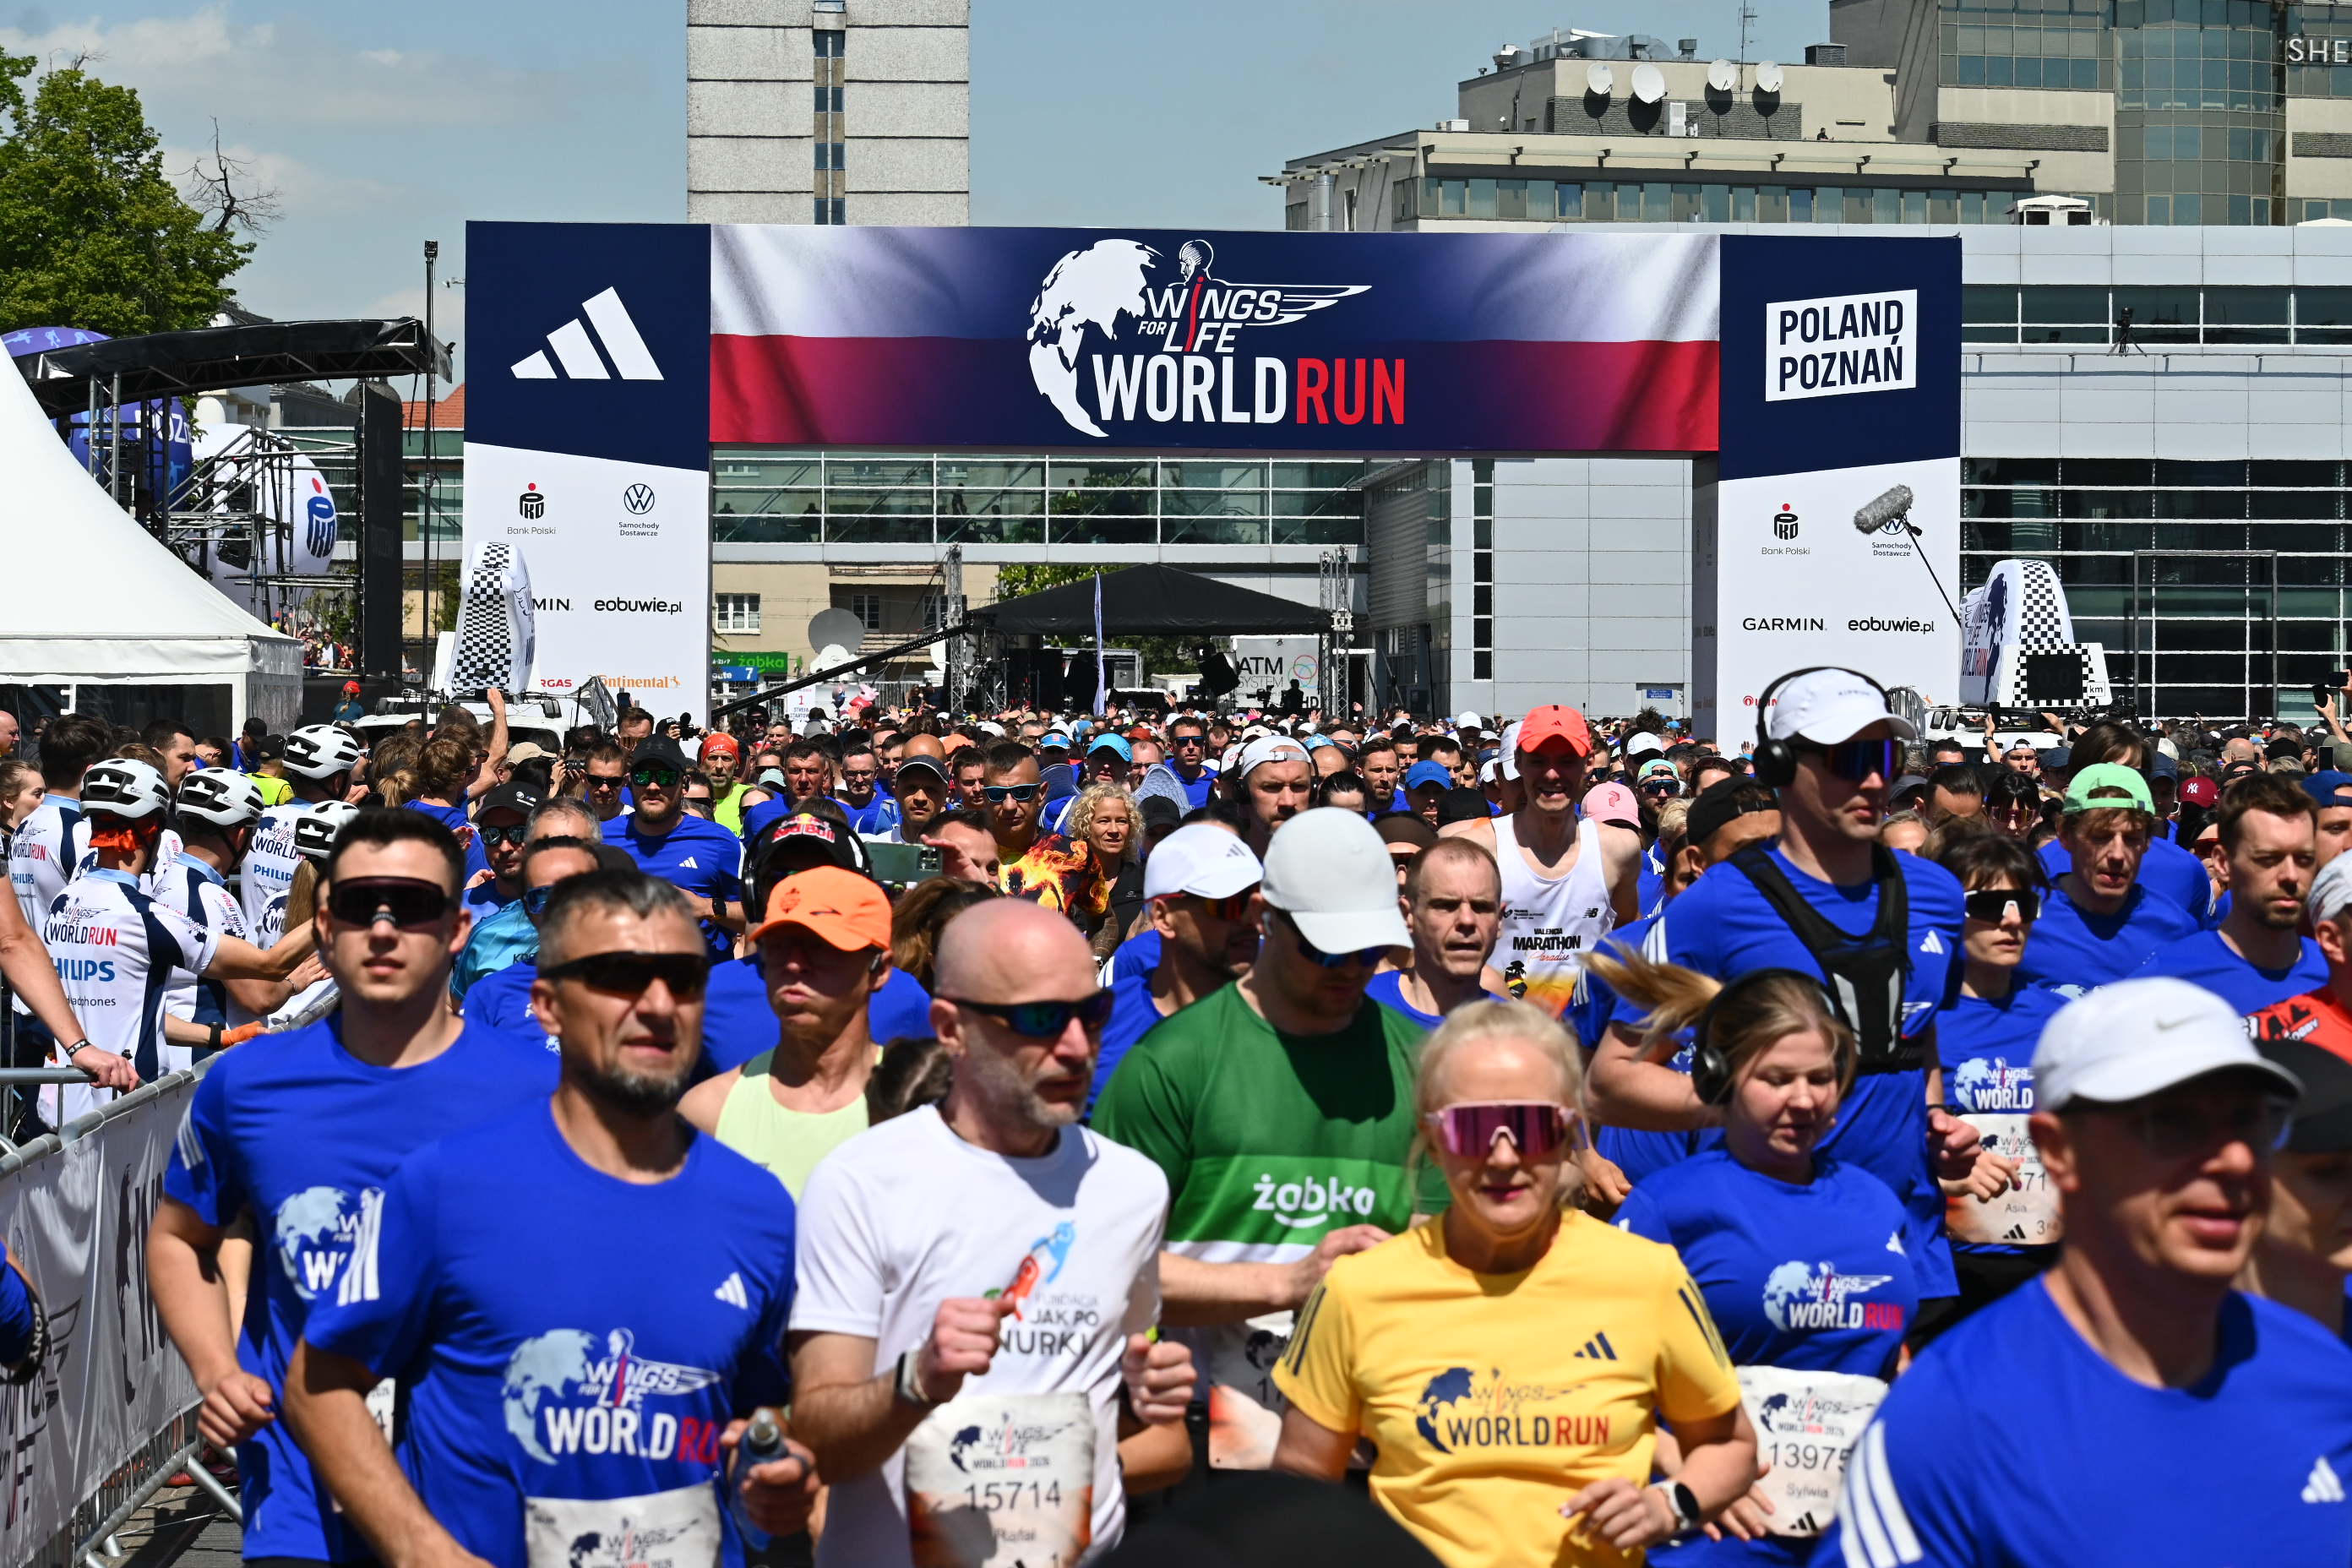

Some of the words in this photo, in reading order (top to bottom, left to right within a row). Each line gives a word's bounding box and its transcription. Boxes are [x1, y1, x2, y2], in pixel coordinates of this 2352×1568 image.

[2288, 38, 2348, 63] SHE
[1146, 286, 1282, 321] WINGS
[1137, 320, 1168, 335] FOR
[1779, 299, 1904, 345] POLAND
[1162, 321, 1244, 353] LIFE
[1779, 335, 1903, 392] POZNAŃ
[507, 526, 530, 535] Bank
[531, 526, 557, 535] Polski
[618, 521, 660, 531] Samochody
[619, 529, 659, 537] Dostawcze
[1761, 547, 1784, 555] Bank
[1785, 547, 1810, 555] Polski
[1871, 542, 1913, 551] Samochody
[1872, 549, 1911, 558] Dostawcze
[532, 598, 571, 612] MIN
[593, 596, 683, 615] eobuwie.pl
[1742, 618, 1825, 632] GARMIN
[1847, 616, 1935, 634] eobuwie.pl
[738, 655, 786, 669] żabka
[1239, 656, 1283, 675] ATM
[597, 674, 669, 689] ontinental
[745, 667, 754, 680] 7
[1238, 675, 1283, 689] SYSTEM
[541, 678, 573, 688] RGAS
[2088, 681, 2104, 694] km
[798, 694, 804, 705] 1
[255, 835, 297, 860] WORLD
[11, 873, 35, 885] PHILIPS
[253, 863, 293, 882] PHILIP
[49, 922, 89, 945] WORLD
[89, 926, 117, 947] RUN
[1512, 935, 1582, 950] MARATHON
[52, 957, 116, 983] HILIPS
[1974, 1087, 2034, 1110] WORLD
[1252, 1173, 1376, 1217] żabka
[2005, 1202, 2028, 1214] Asia
[1808, 1276, 1861, 1291] WINGS
[1030, 1309, 1069, 1326] JAK
[1073, 1310, 1099, 1326] PO
[1788, 1301, 1865, 1330] WORLD
[1864, 1302, 1905, 1331] RUN
[585, 1357, 682, 1390] WINGS
[1446, 1417, 1551, 1447] WORLD
[1555, 1415, 1609, 1446] RUN
[677, 1416, 721, 1464] RU
[1768, 1441, 1852, 1473] 13975
[964, 1478, 1062, 1512] 15714
[1785, 1483, 1830, 1500] Sylwia
